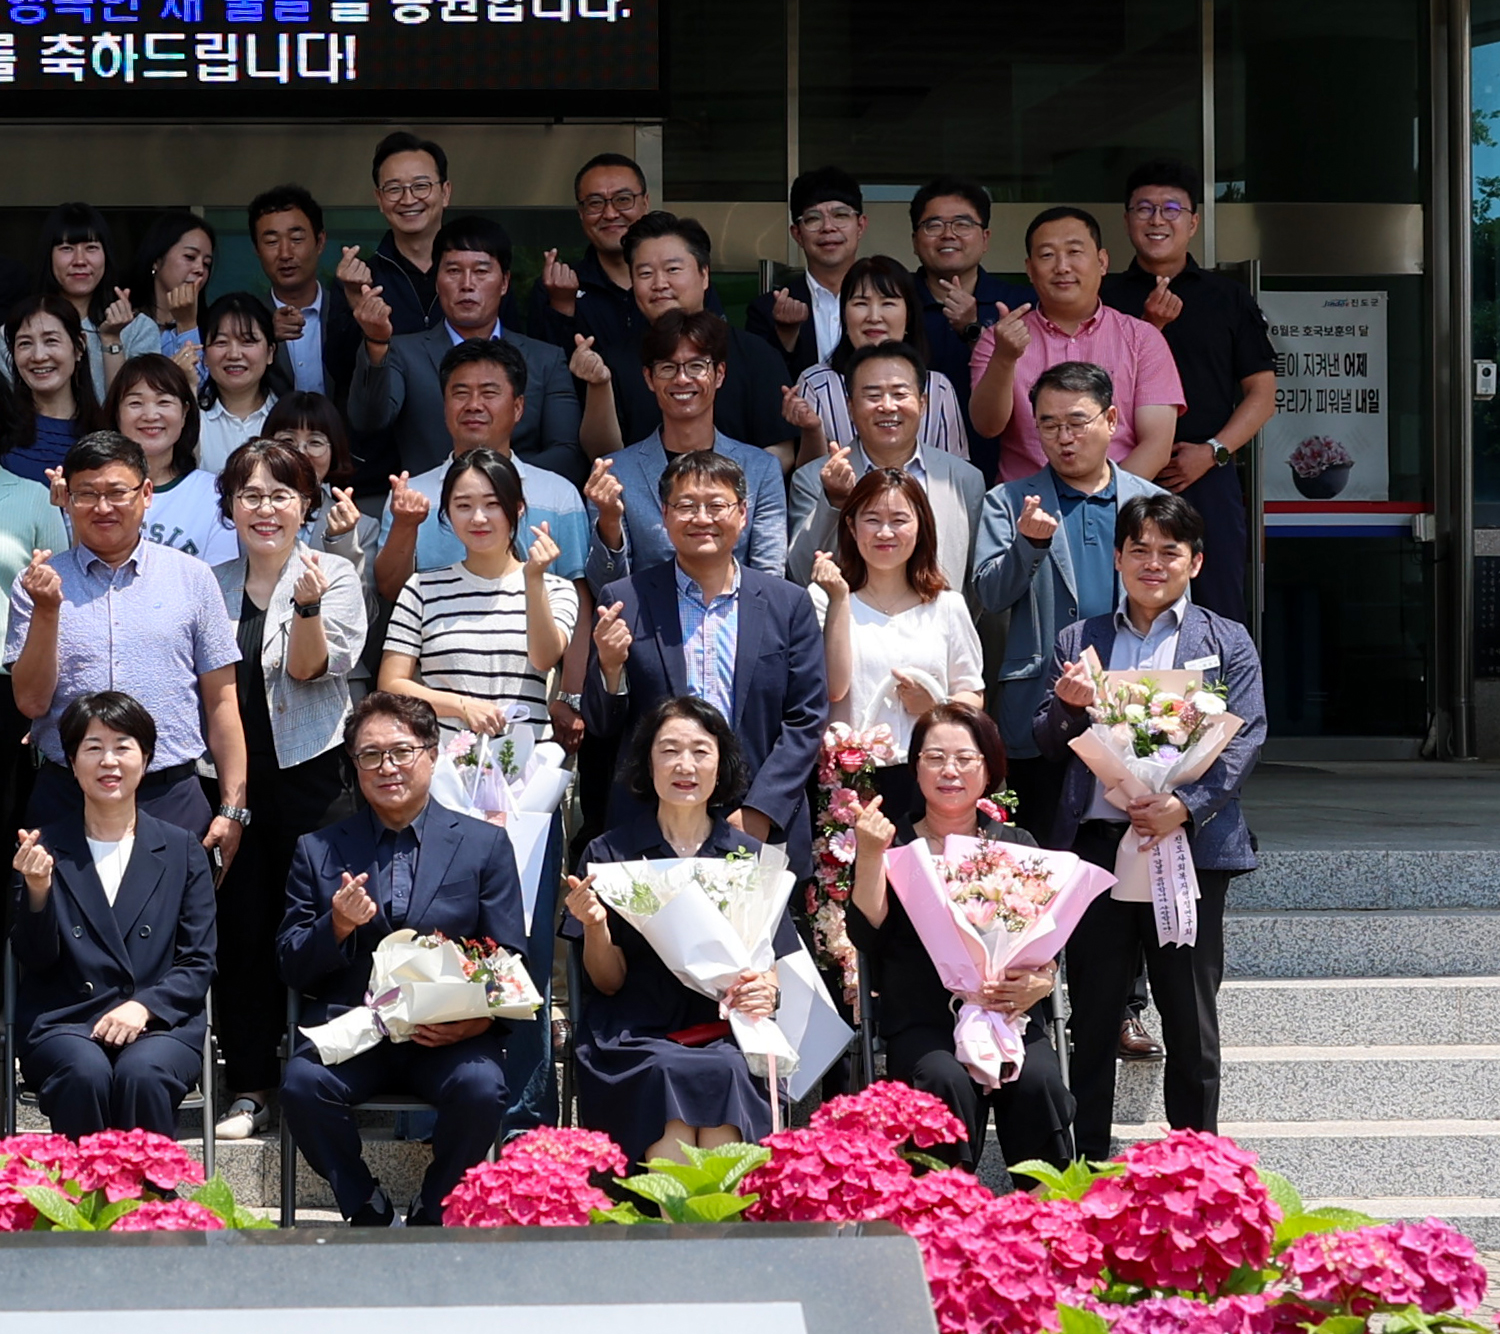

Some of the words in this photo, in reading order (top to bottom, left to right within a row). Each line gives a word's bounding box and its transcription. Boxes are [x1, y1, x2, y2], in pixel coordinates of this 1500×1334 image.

[40, 31, 356, 84] 축하드립니다!
[1350, 298, 1379, 308] 진도군
[1271, 325, 1300, 337] 6월은
[1302, 325, 1356, 337] 호국보훈의
[1358, 325, 1369, 337] 달
[1303, 352, 1341, 378] 지켜낸
[1343, 353, 1369, 378] 어제
[1275, 388, 1313, 414] 우리가
[1315, 388, 1353, 414] 피워낼
[1355, 388, 1380, 414] 내일
